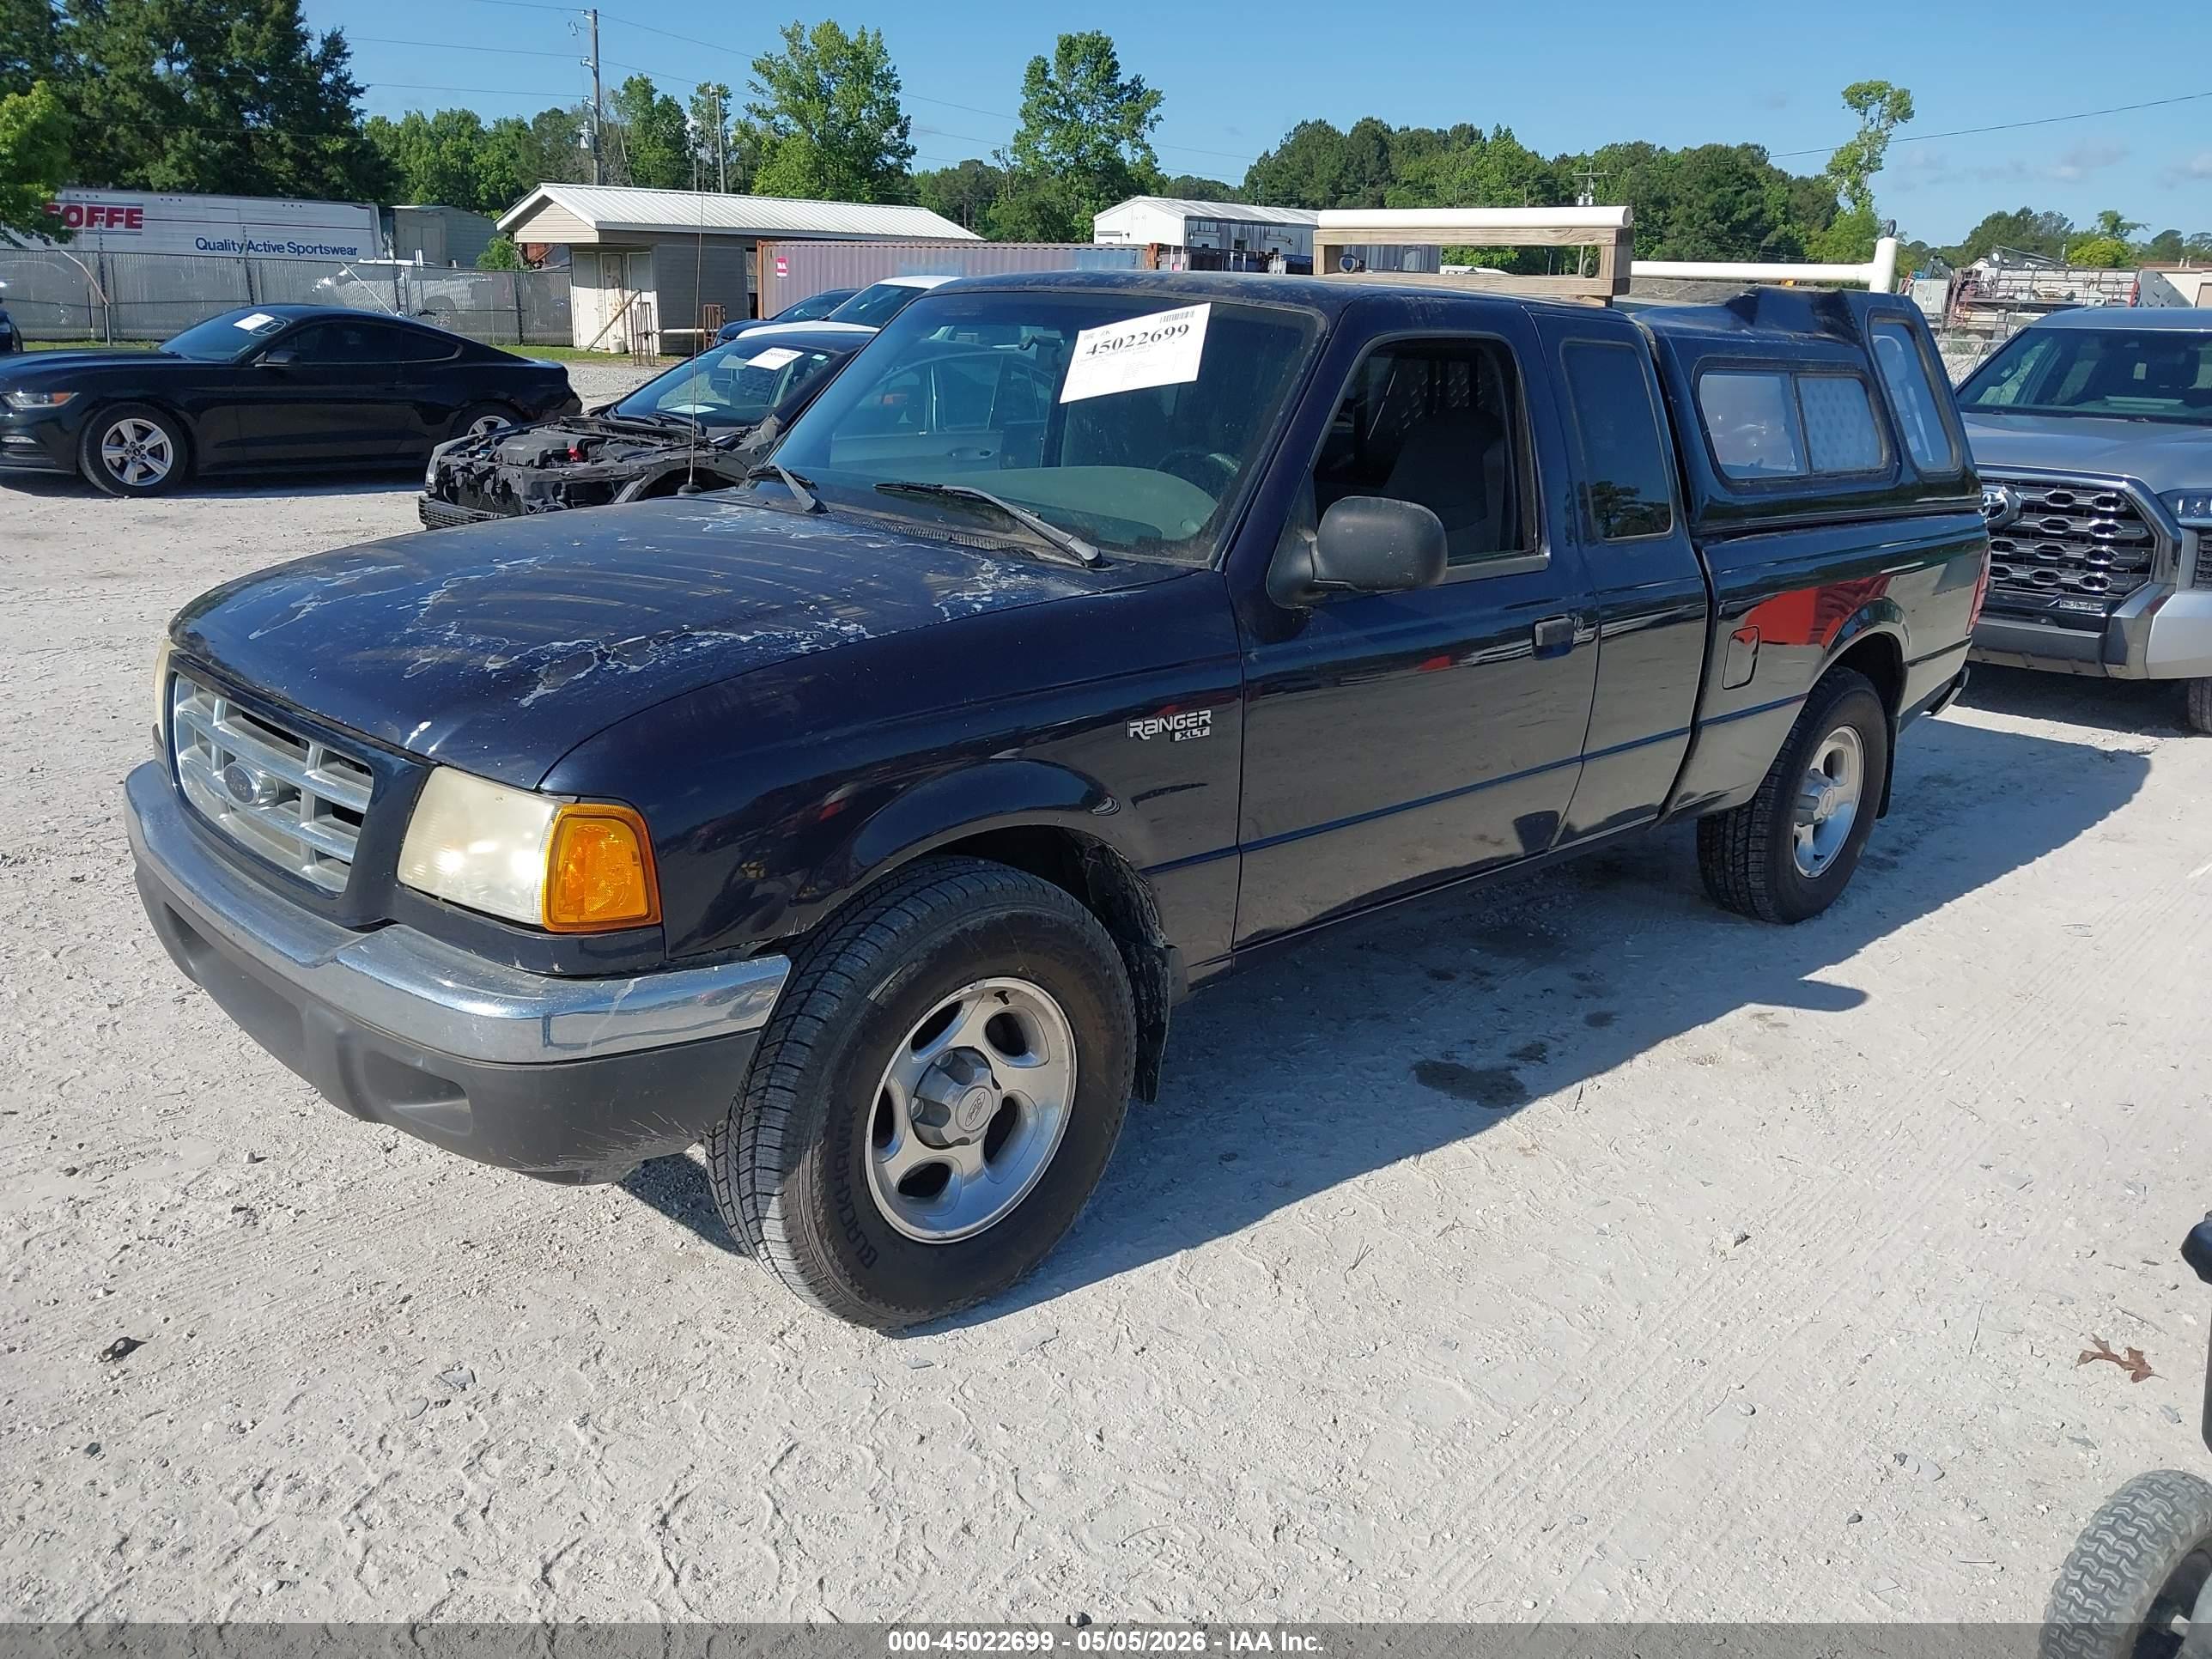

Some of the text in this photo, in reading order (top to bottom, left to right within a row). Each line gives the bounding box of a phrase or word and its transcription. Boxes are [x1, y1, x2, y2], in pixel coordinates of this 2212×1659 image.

[195, 237, 358, 257] Quality Active Sportswear
[1085, 324, 1190, 356] 45022699
[1128, 709, 1212, 741] RANGER
[1177, 727, 1208, 740] XLT
